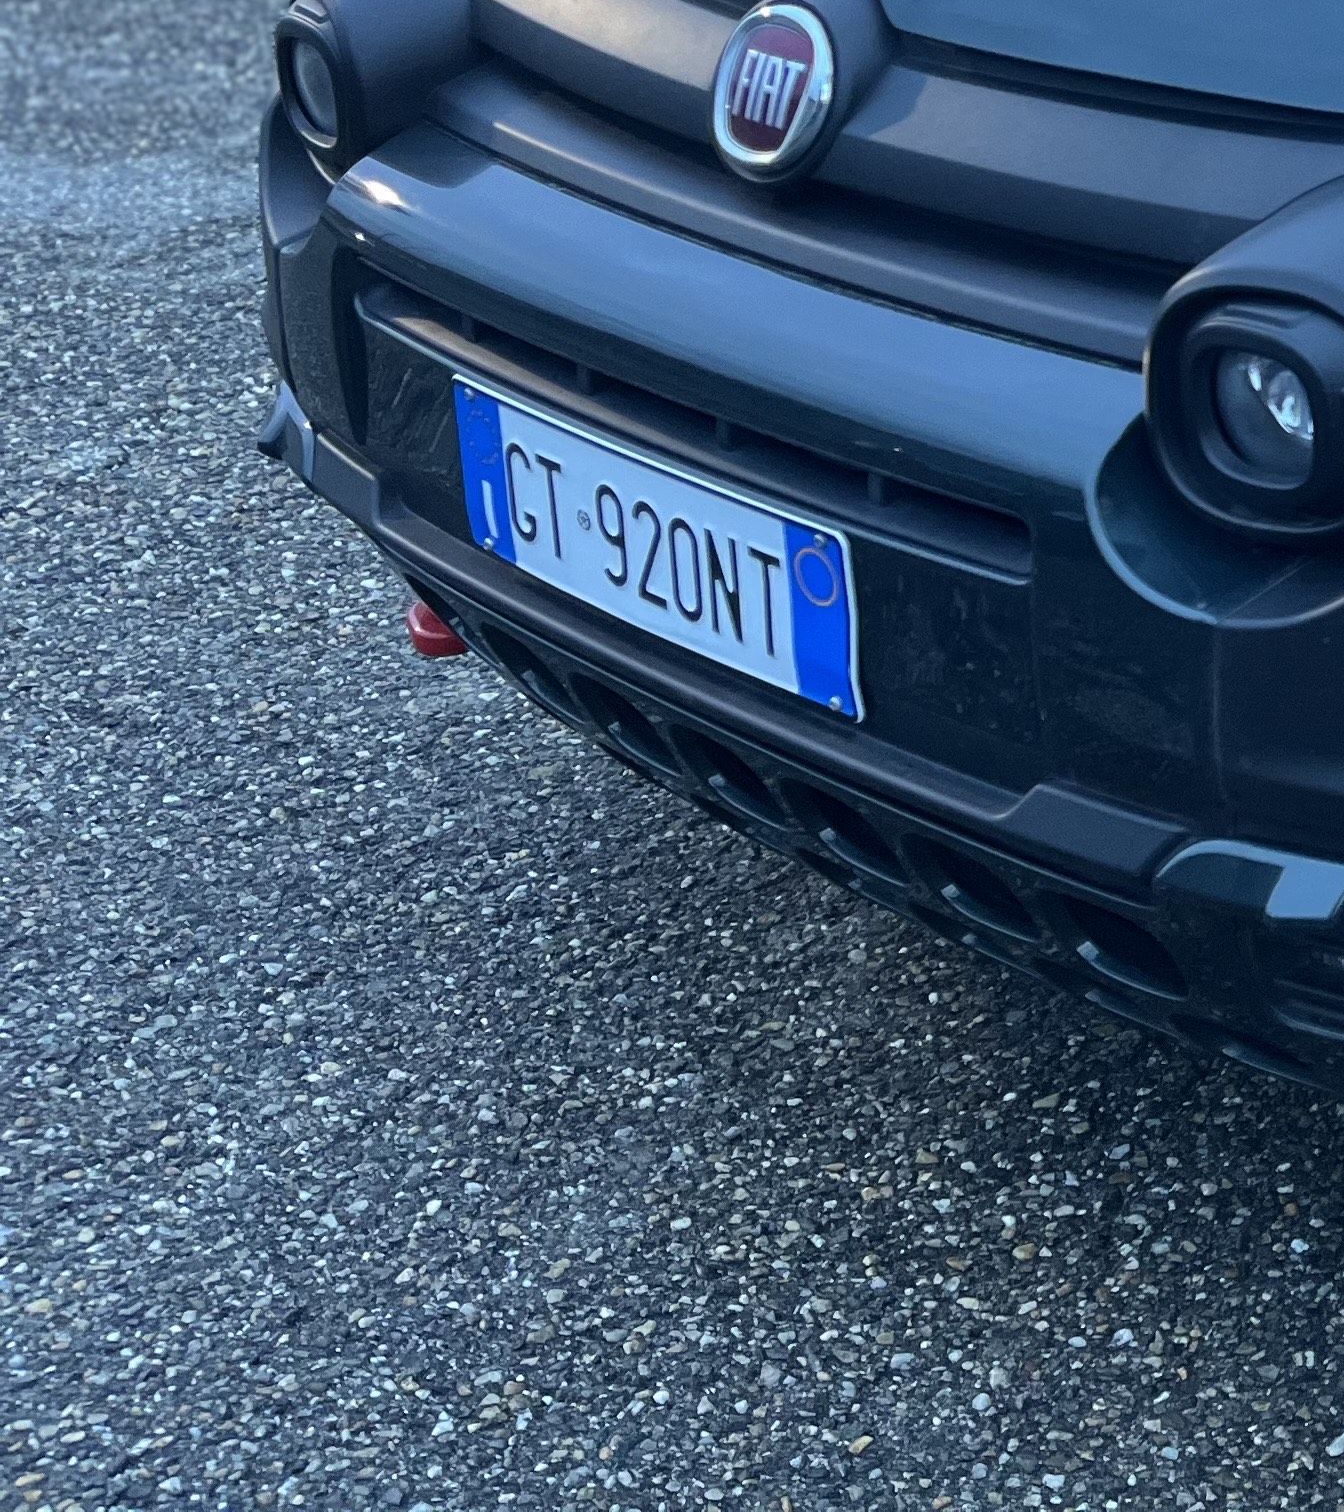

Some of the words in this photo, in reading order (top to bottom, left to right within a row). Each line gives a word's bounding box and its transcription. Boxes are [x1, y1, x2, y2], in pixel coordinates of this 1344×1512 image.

[732, 48, 807, 130] FIAT
[505, 442, 562, 560] GT
[595, 484, 781, 657] 920NT
